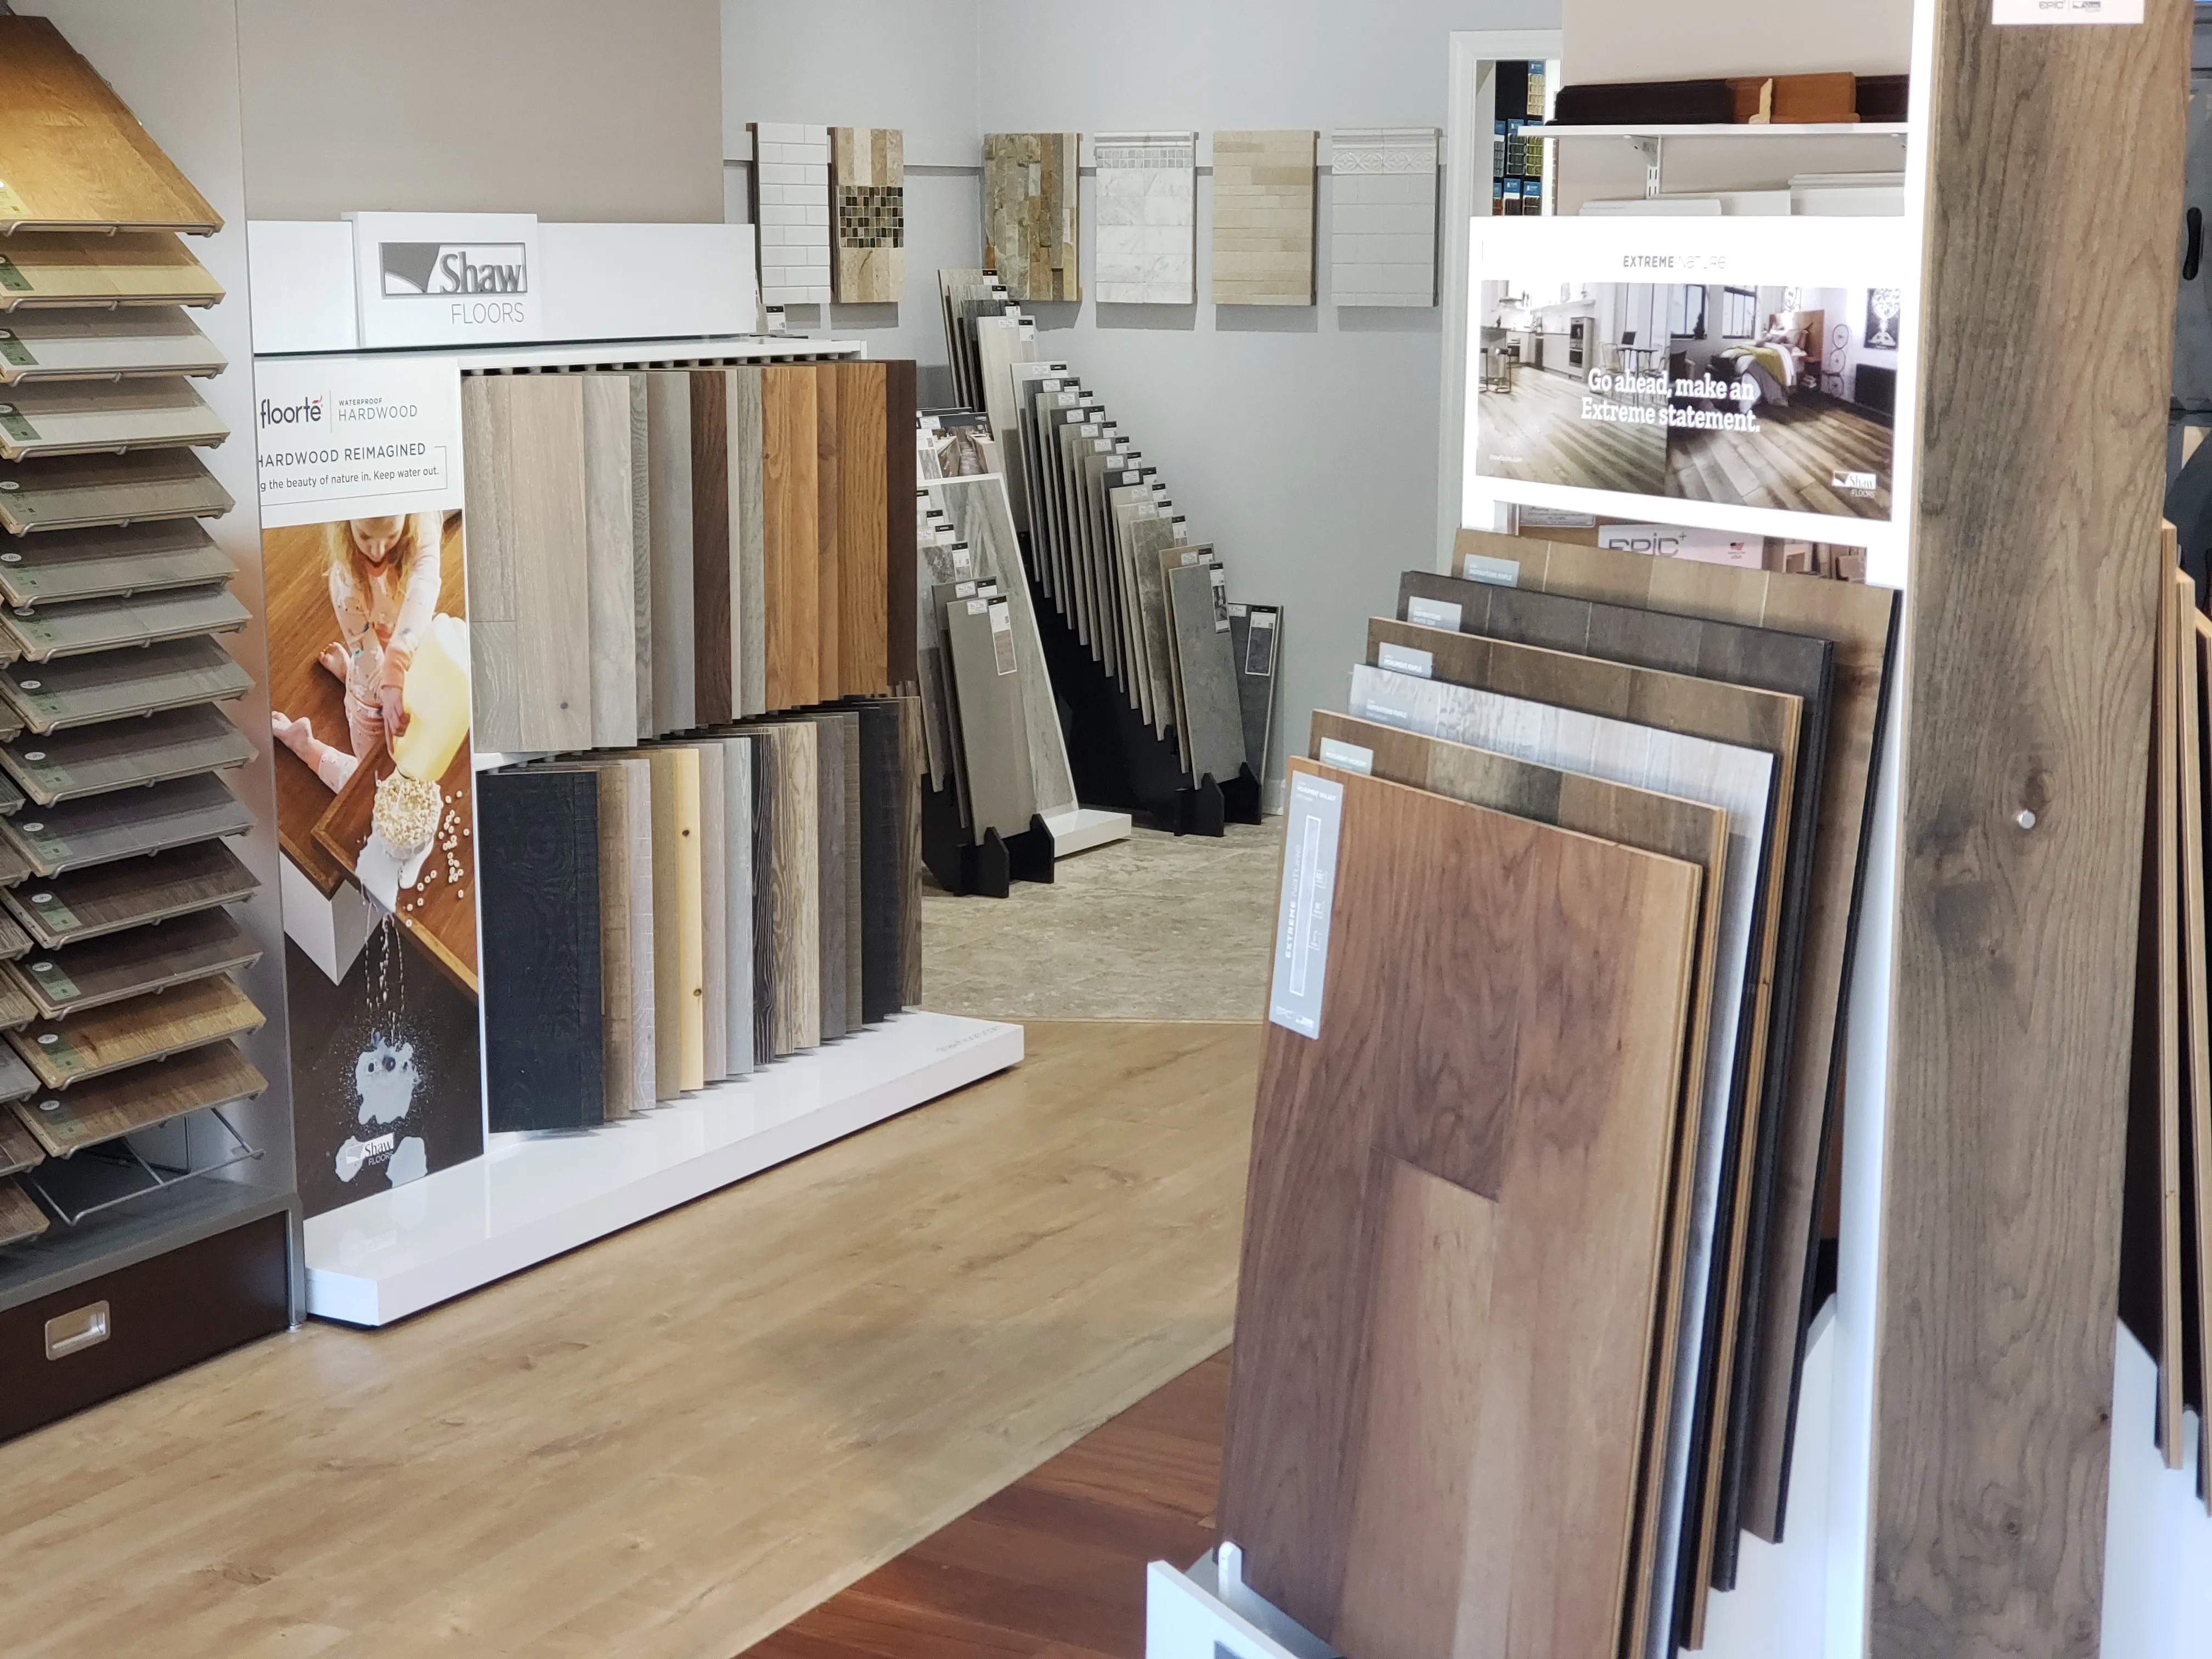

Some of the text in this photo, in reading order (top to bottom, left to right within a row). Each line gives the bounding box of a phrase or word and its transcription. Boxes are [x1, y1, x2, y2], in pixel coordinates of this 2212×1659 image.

[1623, 255, 1674, 268] EXTREME
[439, 251, 521, 294] Shaw
[452, 302, 524, 324] FLOORS
[1588, 368, 1755, 400] Go ahead, make an
[338, 398, 383, 407] WATERPROOF
[338, 405, 417, 422] HARDWOOD
[1581, 397, 1760, 432] Extreme statement.
[345, 443, 426, 461] REIMAGINED
[269, 479, 284, 489] the
[286, 476, 317, 488] beauty
[320, 475, 329, 485] of
[331, 473, 359, 484] nature
[361, 472, 371, 482] in.
[374, 470, 395, 481] Keep
[397, 467, 420, 478] water
[423, 466, 439, 476] out.
[1850, 475, 1875, 488] Shaw
[1285, 900, 1296, 959] EXTREME
[365, 1139, 392, 1157] Shaw
